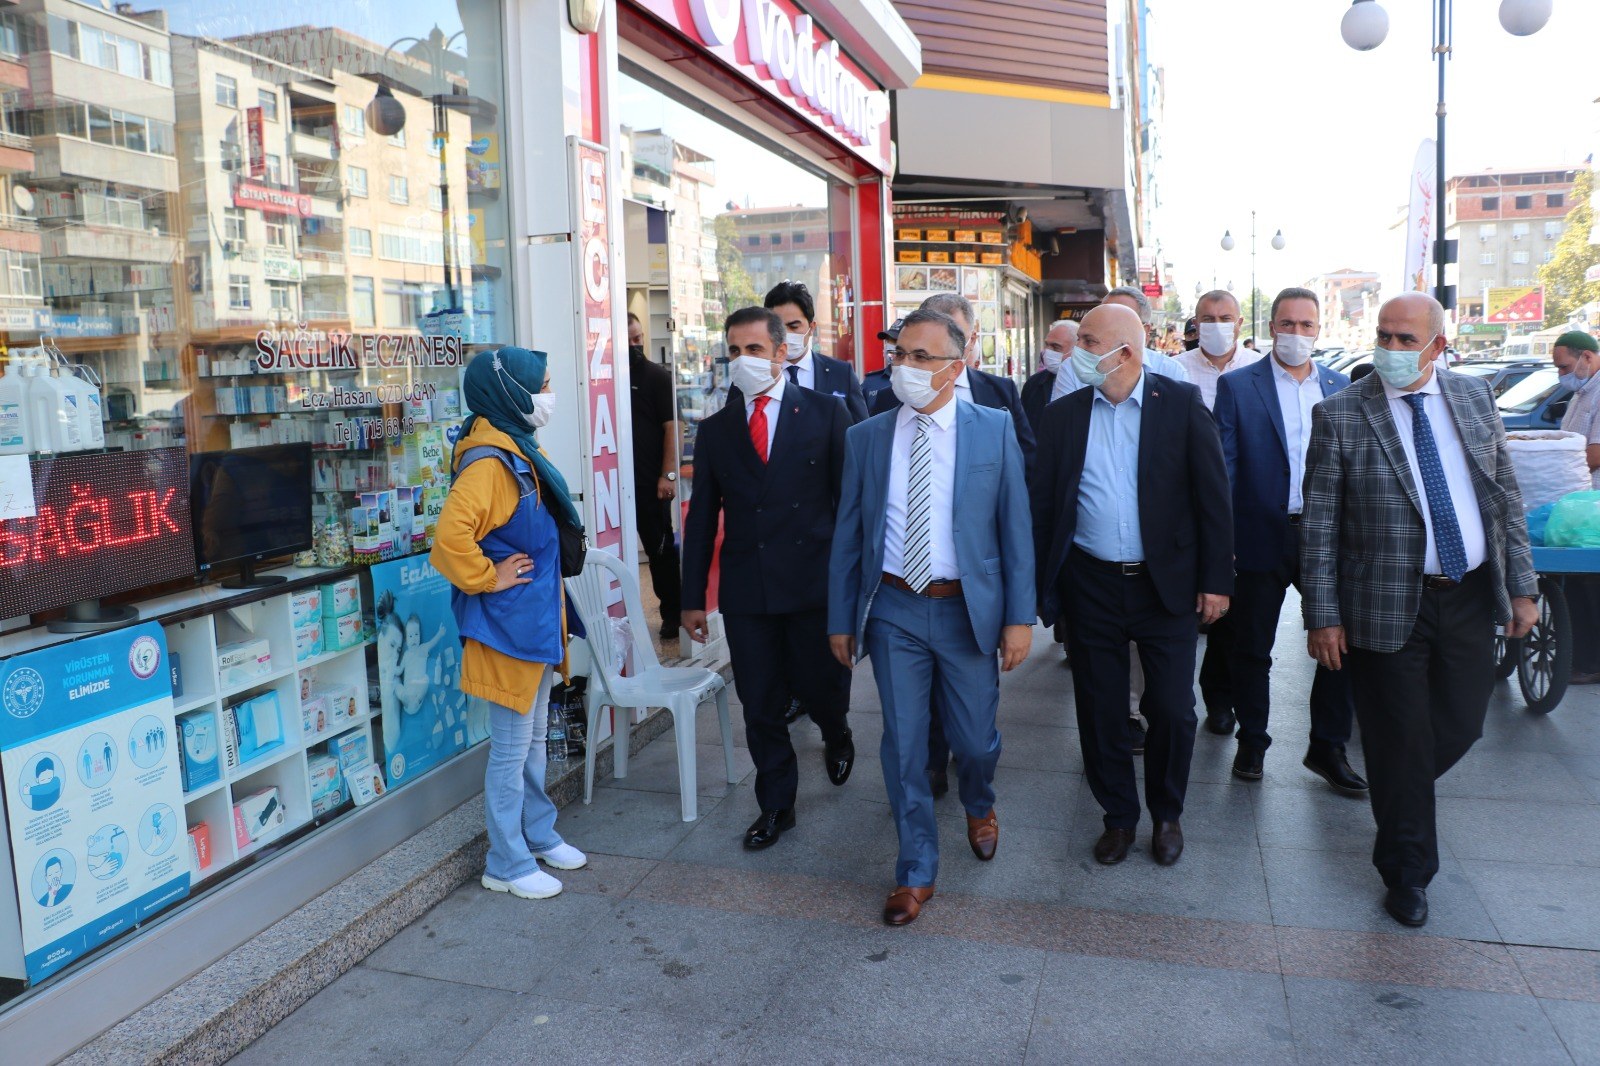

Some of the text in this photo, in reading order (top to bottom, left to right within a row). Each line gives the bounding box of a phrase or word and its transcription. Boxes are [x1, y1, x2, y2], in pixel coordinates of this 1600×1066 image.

[256, 322, 358, 370] SAĞLIK
[361, 329, 463, 369] ECZANESİ
[301, 379, 437, 409] Ecz. Hasan ÖZDOĞAN
[335, 422, 354, 443] Tel
[363, 419, 383, 441] 715
[386, 417, 399, 437] 68
[402, 416, 415, 436] 18
[422, 446, 440, 459] Bebe
[0, 482, 179, 568] SAĞLIK
[62, 664, 115, 689] KORUNMAK
[64, 653, 110, 674] VİRÜSTEN
[69, 679, 111, 701] ELİMİZDE
